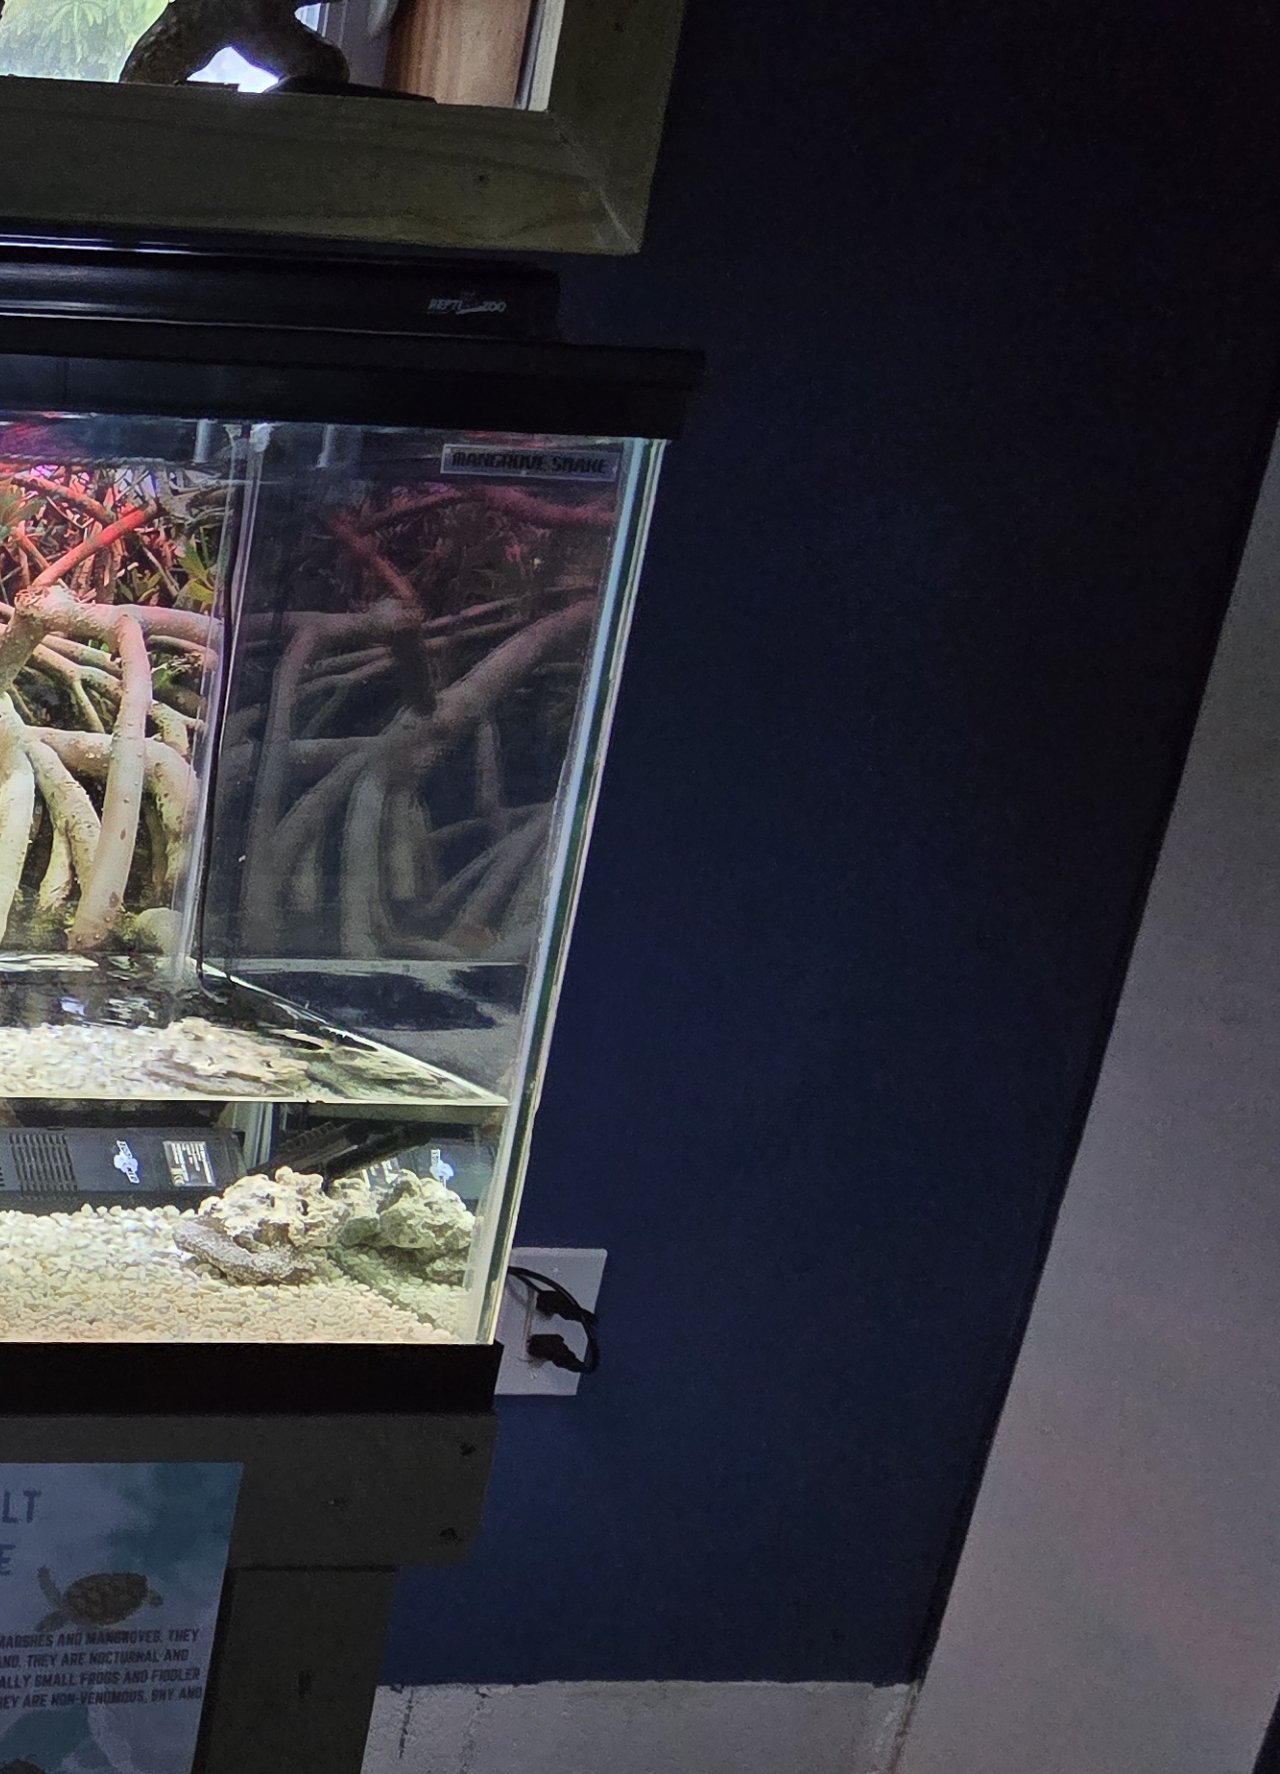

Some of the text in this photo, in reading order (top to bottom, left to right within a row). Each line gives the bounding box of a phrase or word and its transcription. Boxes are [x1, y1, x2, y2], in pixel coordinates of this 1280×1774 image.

[452, 451, 608, 474] MANGROVE SNAKE
[57, 1631, 82, 1647] AND
[86, 1629, 163, 1645] MANGROVES.
[168, 1628, 200, 1643] THEY
[27, 1654, 57, 1668] THEY
[61, 1652, 86, 1666] ARE
[89, 1649, 160, 1665] NOCTURNAL
[164, 1648, 189, 1662] AND
[35, 1673, 75, 1688] SMALL
[80, 1671, 120, 1686] FROGS
[123, 1669, 148, 1683] AND
[151, 1667, 200, 1682] FIDDLER
[23, 1693, 48, 1708] ARE
[151, 1688, 174, 1702] SHY
[178, 1686, 203, 1700] AND
